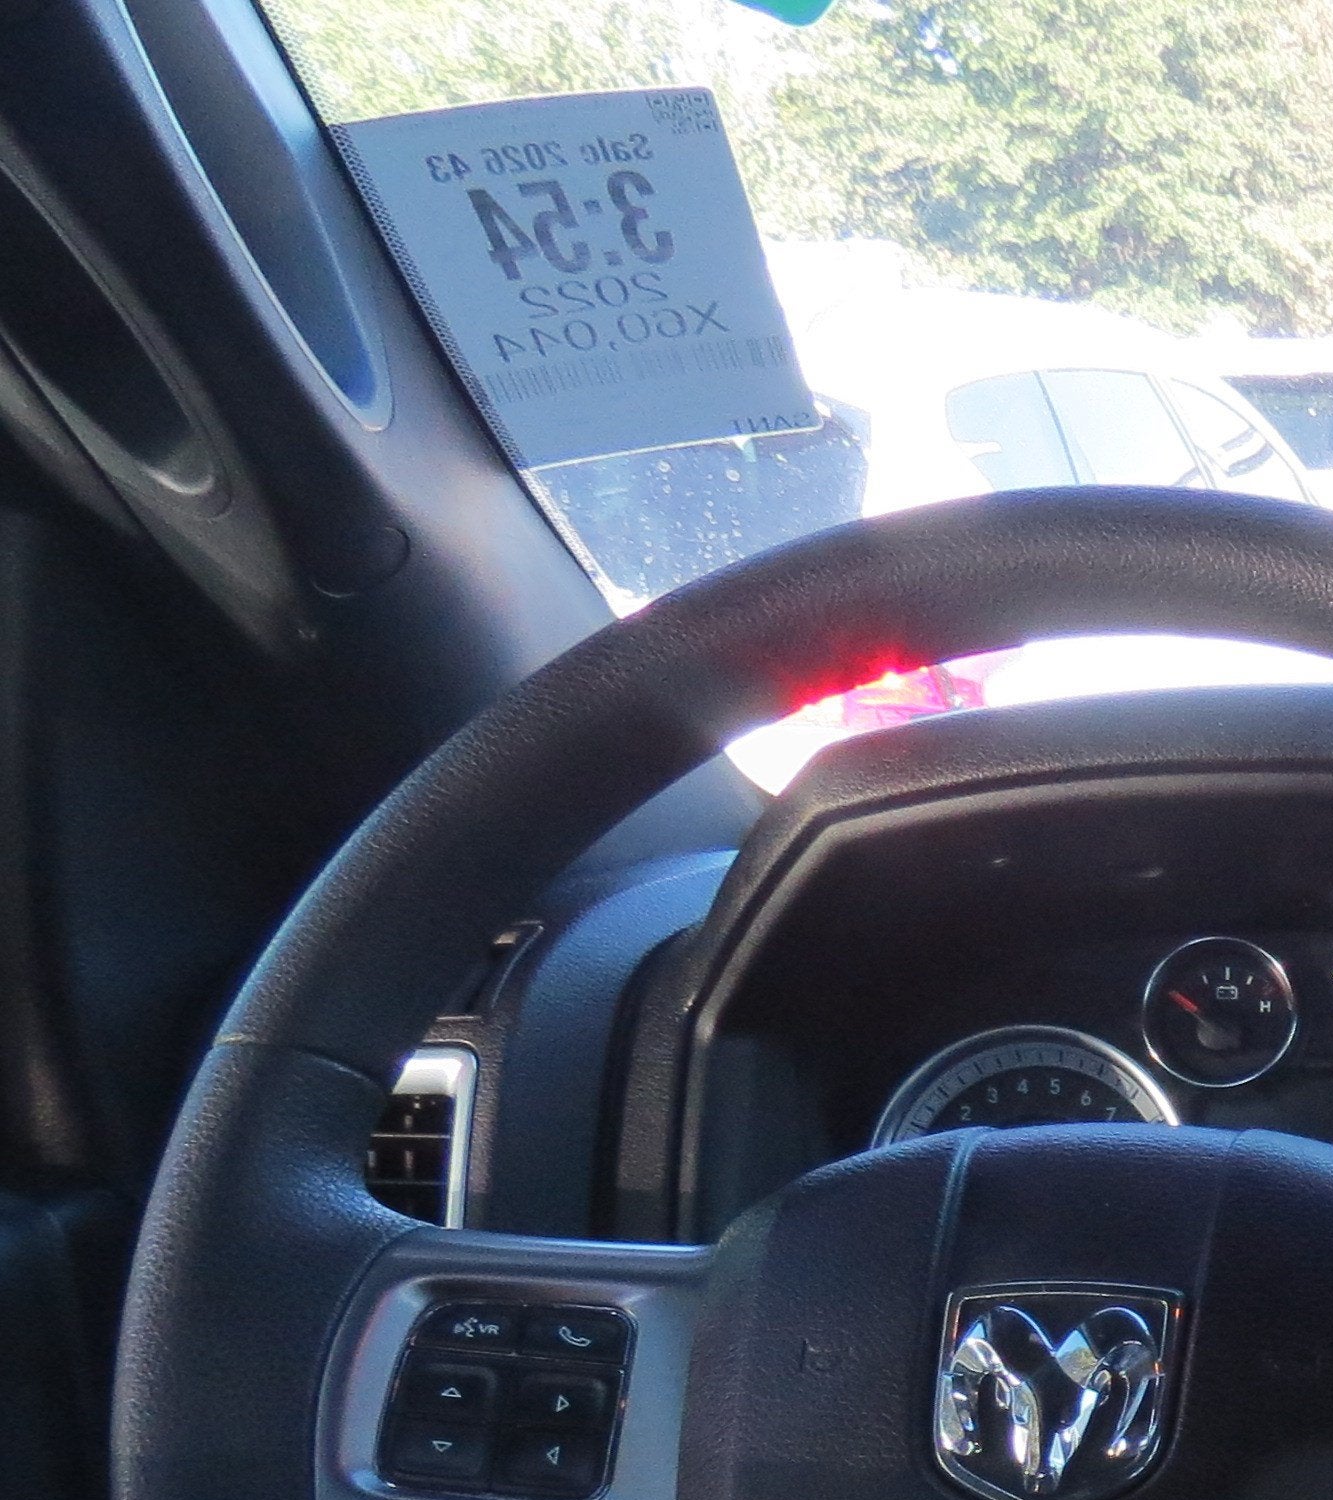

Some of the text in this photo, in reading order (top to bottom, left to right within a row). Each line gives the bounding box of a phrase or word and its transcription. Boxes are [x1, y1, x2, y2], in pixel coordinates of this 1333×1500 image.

[1258, 1000, 1272, 1013] H
[960, 1105, 972, 1121] 2
[987, 1087, 999, 1104] 3
[1016, 1079, 1030, 1095] 4
[1049, 1078, 1061, 1095] 5
[1080, 1089, 1093, 1106] 6
